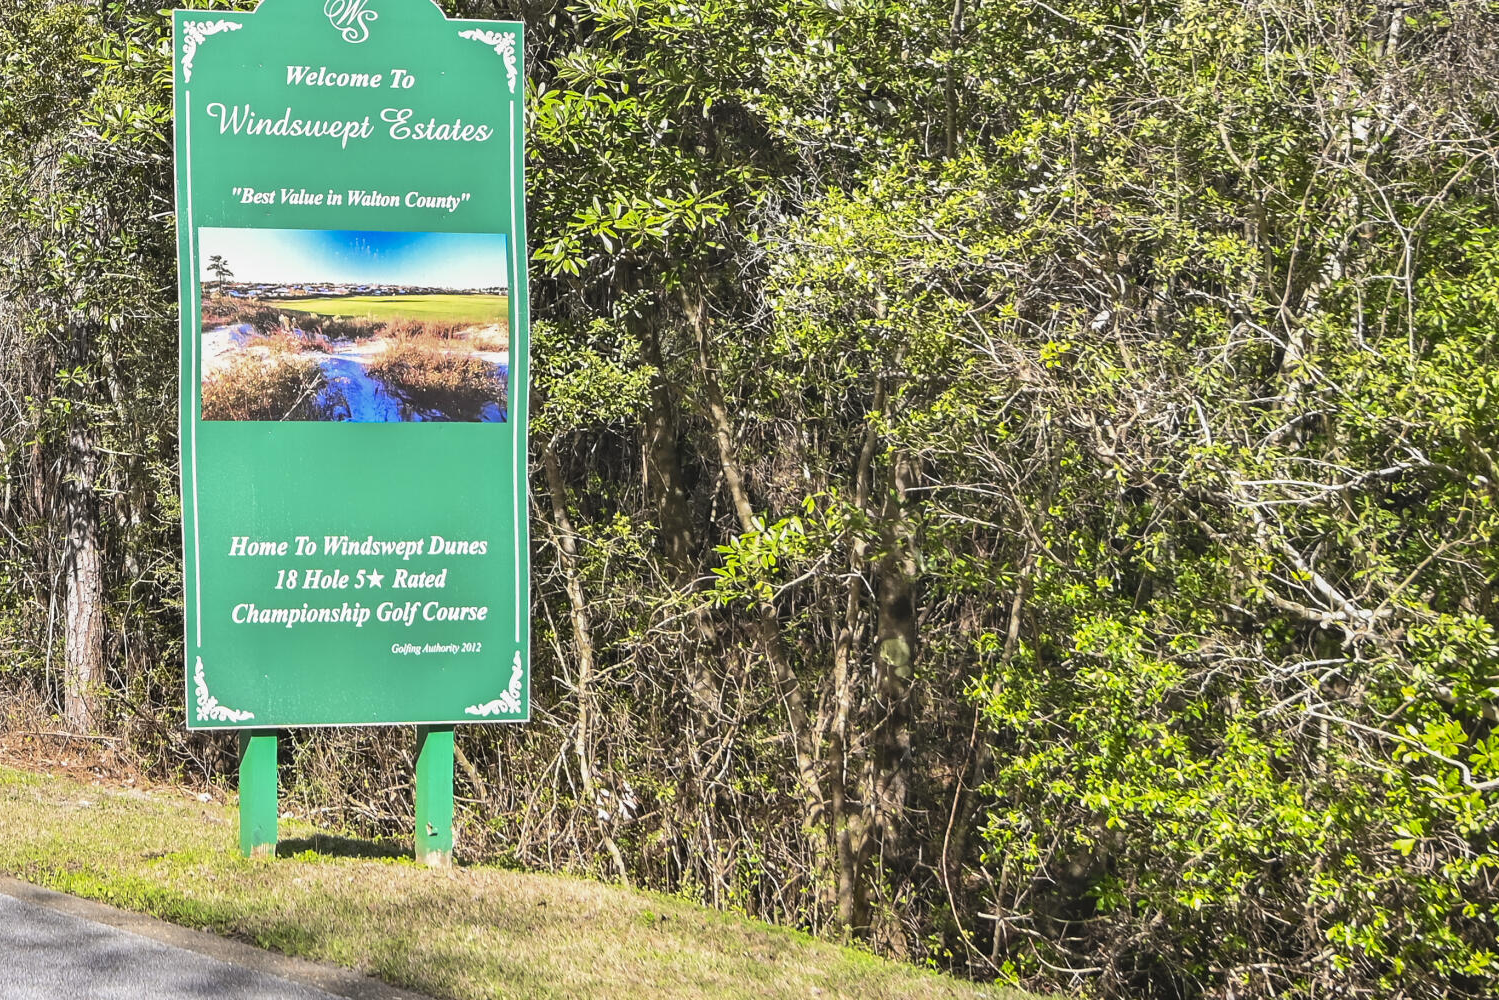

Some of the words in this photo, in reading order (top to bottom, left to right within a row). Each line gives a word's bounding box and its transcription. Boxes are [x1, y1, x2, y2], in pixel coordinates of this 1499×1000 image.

[286, 65, 383, 88] Welcome
[389, 68, 415, 89] To
[206, 102, 374, 149] Windswept
[380, 108, 494, 142] Estates
[231, 187, 276, 205] "Best
[280, 188, 324, 207] Value
[326, 190, 343, 206] in
[348, 190, 401, 208] Walton
[405, 191, 471, 212] County"
[228, 536, 288, 556] Home
[294, 536, 318, 556] To
[323, 536, 425, 561] Windswept
[427, 536, 488, 555] Dunes
[274, 569, 298, 590] 18
[302, 569, 349, 589] Hole
[392, 568, 448, 589] Rated
[231, 602, 371, 629] Championship
[376, 602, 421, 627] Golf
[422, 602, 488, 621] Course
[391, 642, 421, 655] Golfing
[422, 643, 459, 655] Authority
[461, 642, 482, 653] 2012
